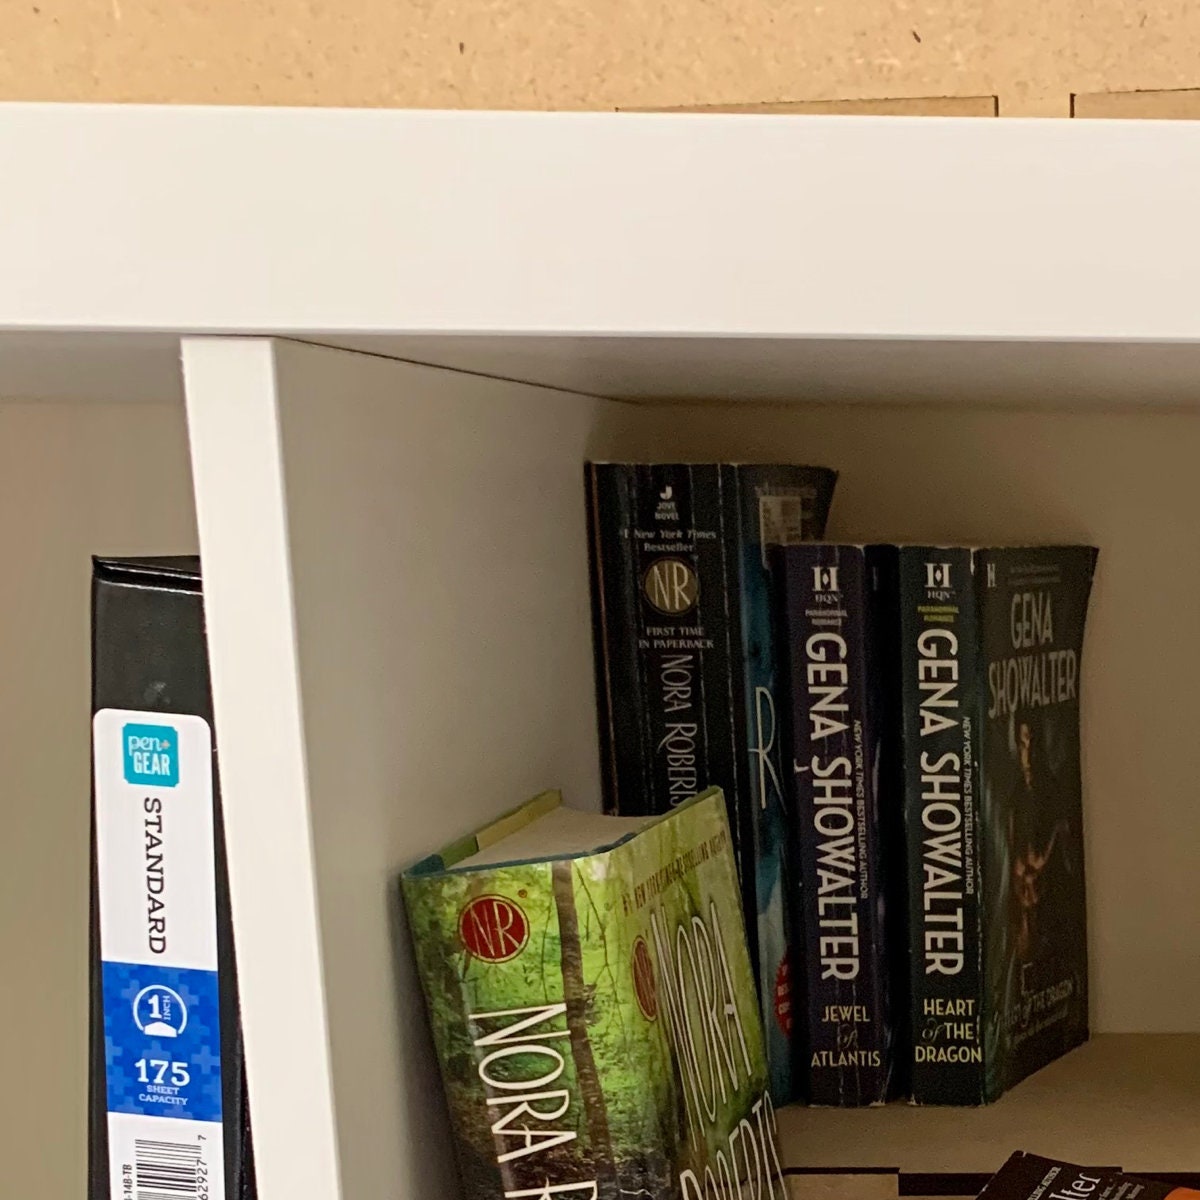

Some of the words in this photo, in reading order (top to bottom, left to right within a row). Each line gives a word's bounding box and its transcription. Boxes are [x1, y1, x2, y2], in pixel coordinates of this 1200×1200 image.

[634, 529, 656, 540] New
[659, 529, 684, 540] York
[687, 529, 717, 541] Times
[644, 542, 694, 553] Bestseller
[653, 562, 692, 611] NR
[646, 626, 676, 637] FIRST
[1010, 591, 1054, 650] GENA
[653, 639, 715, 650] PAPERBACK
[661, 654, 694, 713] NORA
[805, 632, 850, 741] GENA
[917, 628, 960, 738] GENA
[988, 649, 1077, 720] SHOWALTER
[853, 719, 863, 743] NEW
[962, 716, 972, 740] NEW
[133, 751, 172, 777] GEAR
[854, 744, 864, 769] YORK
[962, 740, 973, 766] YORK
[855, 771, 866, 798] TIMES
[963, 768, 973, 794] TIMES
[856, 799, 868, 859] BESTSELLING
[963, 795, 974, 855] BESTSELLING
[143, 796, 167, 955] STANDARD
[811, 755, 861, 981] SHOWALTER
[920, 751, 964, 976] SHOWALTER
[964, 857, 975, 895] AUTHOR
[858, 860, 869, 900] AUTHOR
[467, 900, 526, 959] NR
[147, 994, 163, 1019] 1
[162, 995, 172, 1021] INCH
[821, 1005, 871, 1023] JEWEL
[923, 998, 975, 1016] HEART
[650, 900, 752, 1154] NORA
[944, 1021, 975, 1041] THE
[811, 1050, 881, 1068] ATLANTIS
[915, 1045, 983, 1064] DRAGON
[134, 1058, 191, 1087] 175
[468, 1002, 577, 1164] NORA
[138, 1093, 189, 1106] CAPACITY
[146, 1084, 180, 1096] SHEET
